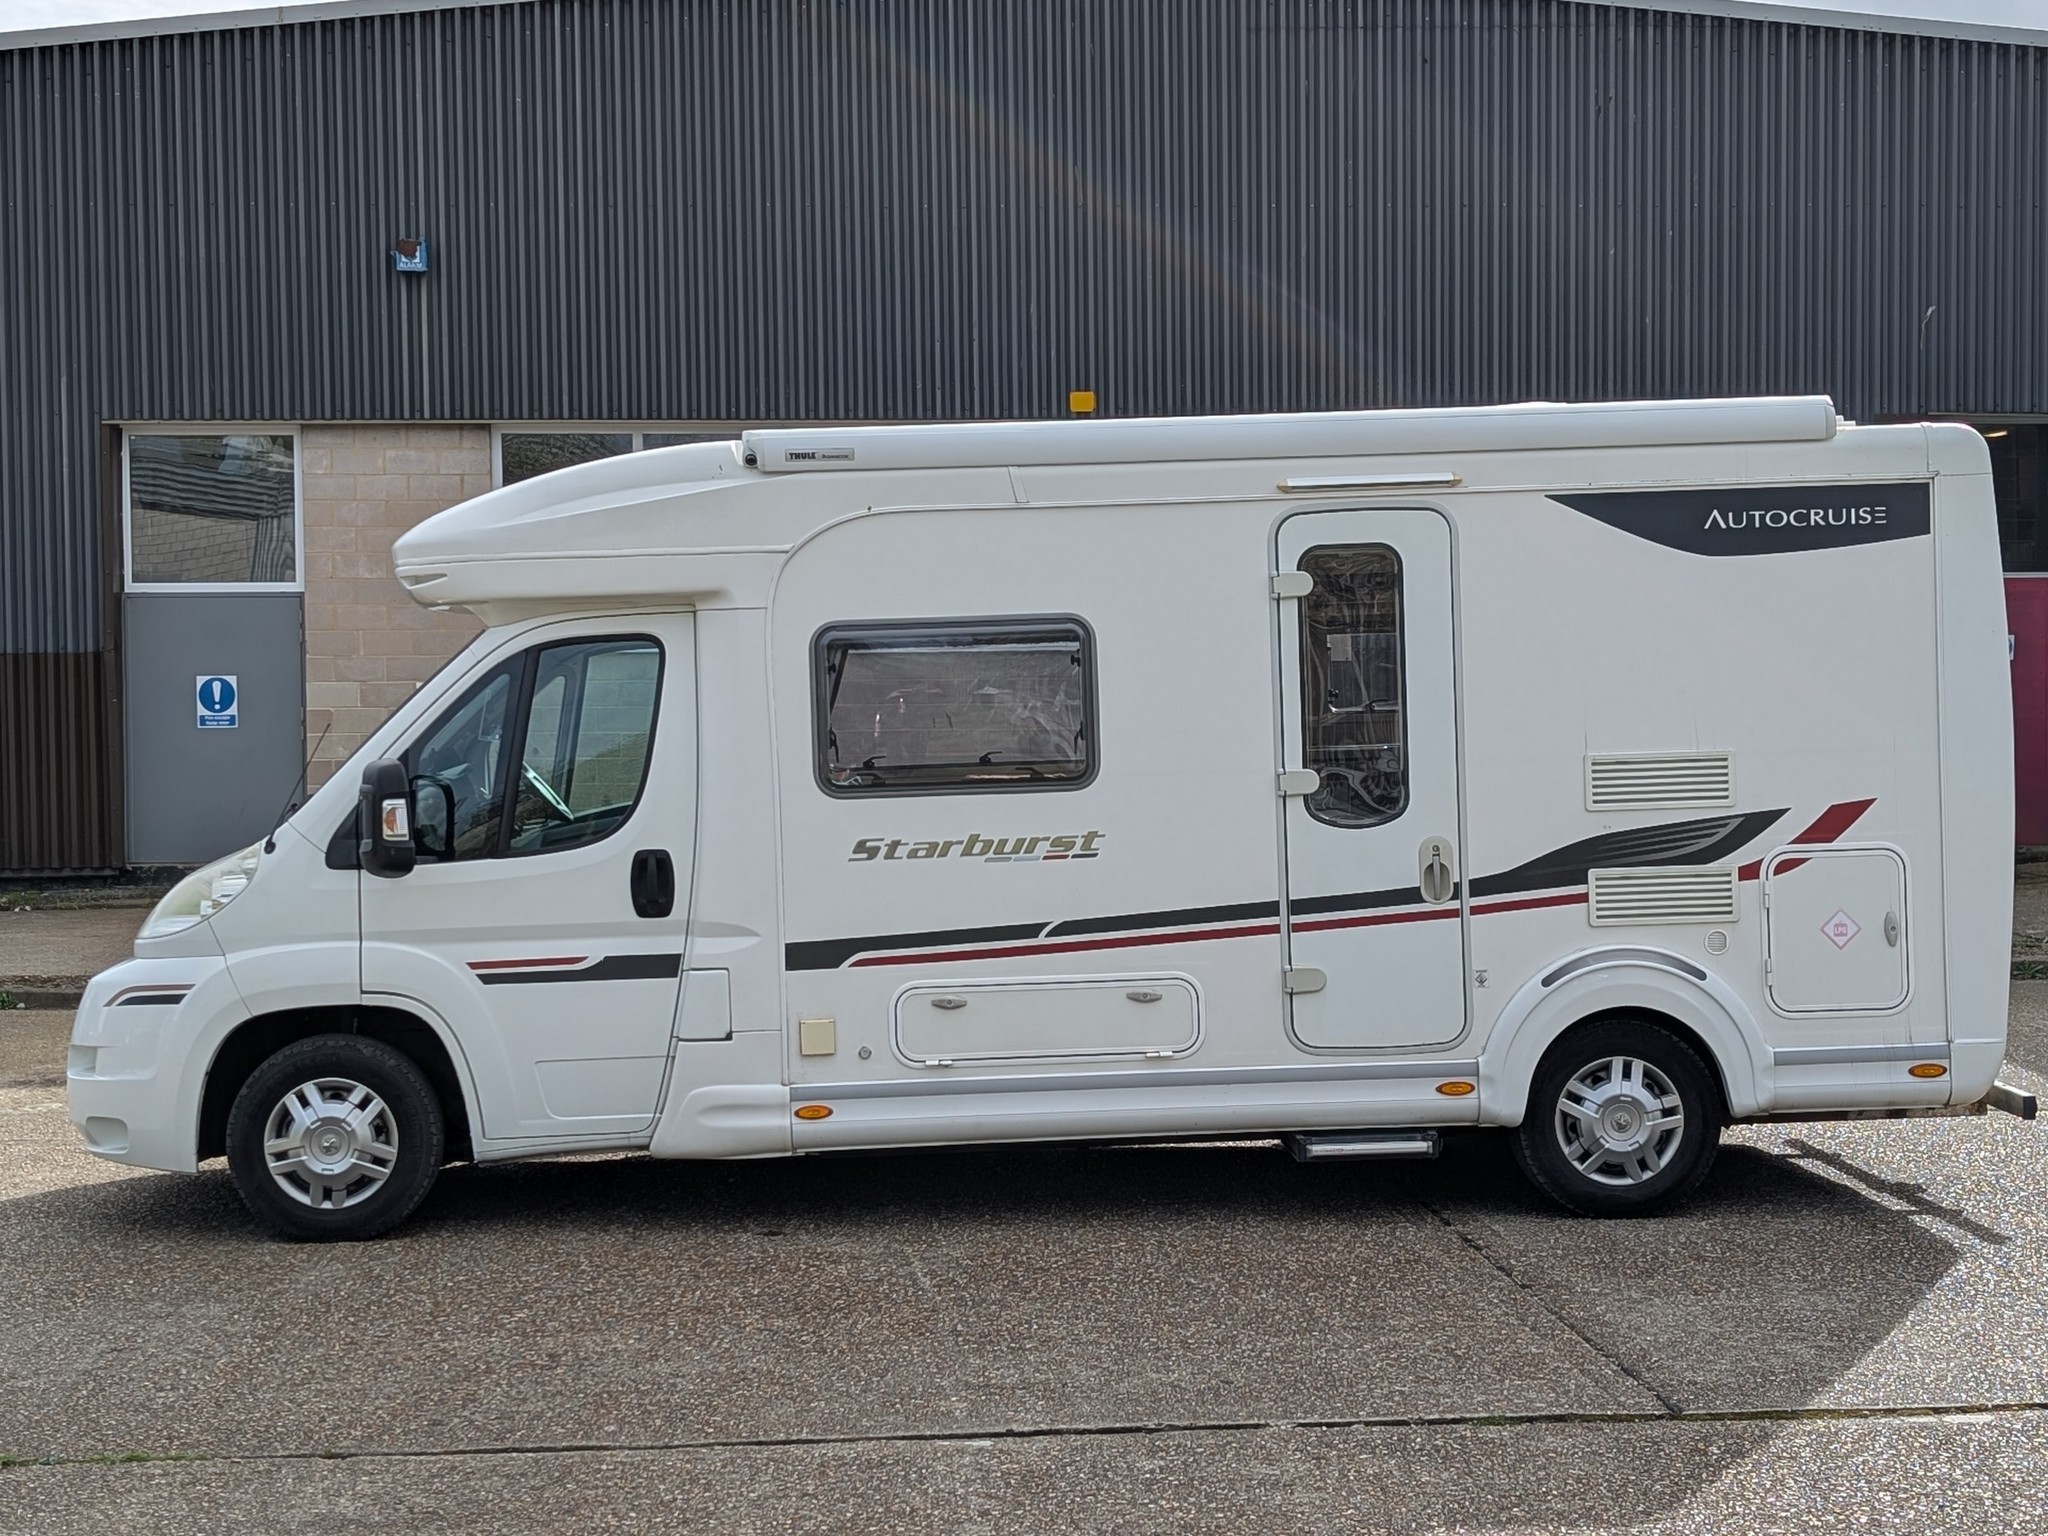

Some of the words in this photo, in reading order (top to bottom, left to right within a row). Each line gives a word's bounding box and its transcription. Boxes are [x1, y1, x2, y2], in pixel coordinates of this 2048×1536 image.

[789, 452, 816, 460] THULE
[1703, 507, 1887, 529] AUTOCRUISE
[848, 831, 1106, 862] Starburst
